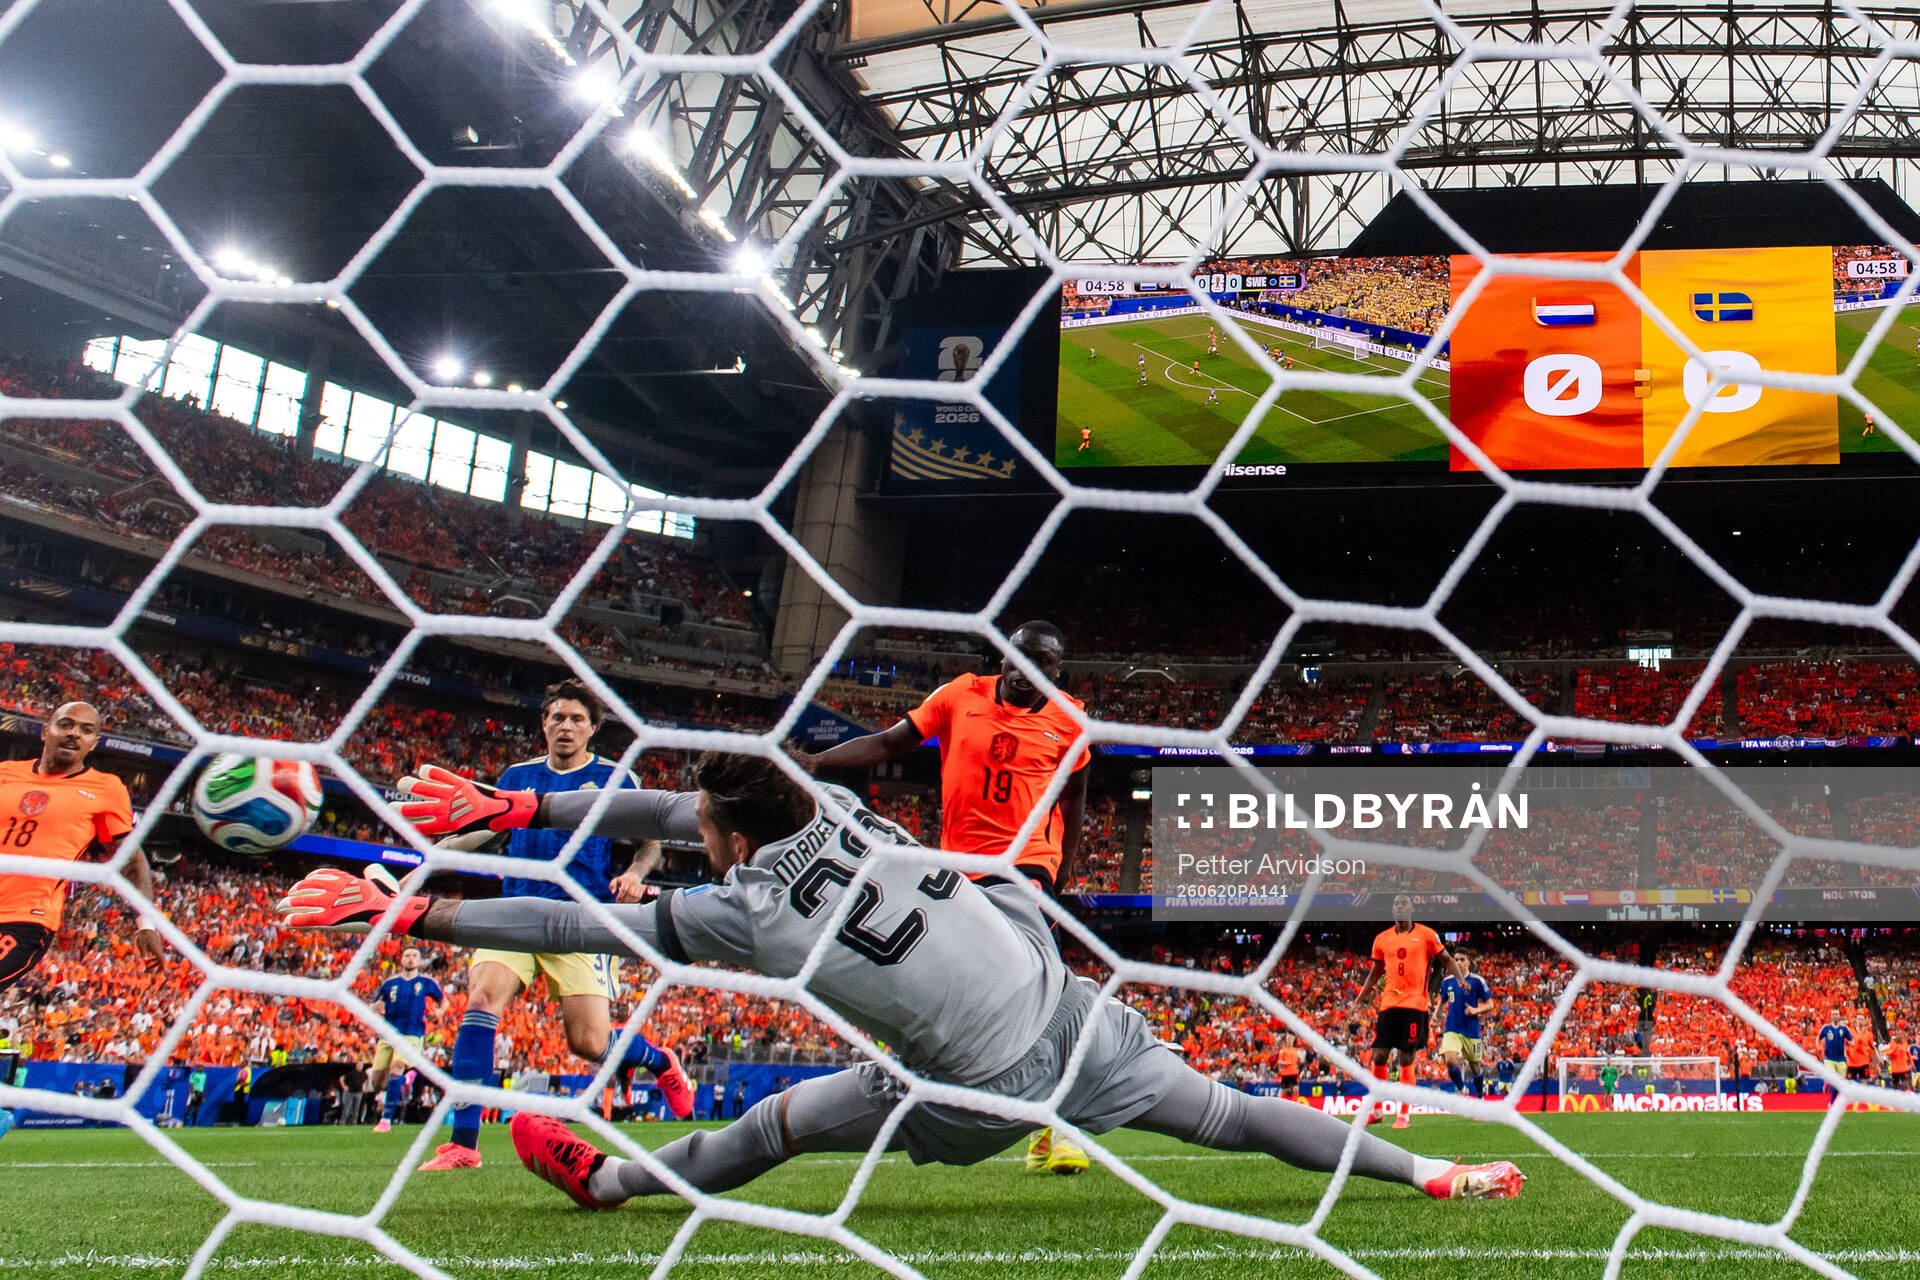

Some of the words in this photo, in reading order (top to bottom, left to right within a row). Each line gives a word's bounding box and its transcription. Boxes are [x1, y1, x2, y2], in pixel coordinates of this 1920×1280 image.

[1857, 262, 1896, 275] 04:58
[1085, 280, 1125, 292] 04:58
[1230, 278, 1238, 289] 0
[1246, 276, 1268, 288] SWE
[935, 413, 980, 423] 2026
[1330, 745, 1372, 754] HOUSTON
[1741, 740, 1759, 748] FIFA
[1160, 747, 1177, 755] FIFA
[982, 765, 1013, 803] 19
[3, 817, 38, 847] 18
[1165, 897, 1188, 907] FIFA
[1189, 897, 1226, 907] WORLD
[1227, 897, 1248, 907] CUP
[1249, 897, 1285, 906] 2026
[1409, 1022, 1418, 1039] 8
[1613, 1093, 1764, 1112] McDonald's
